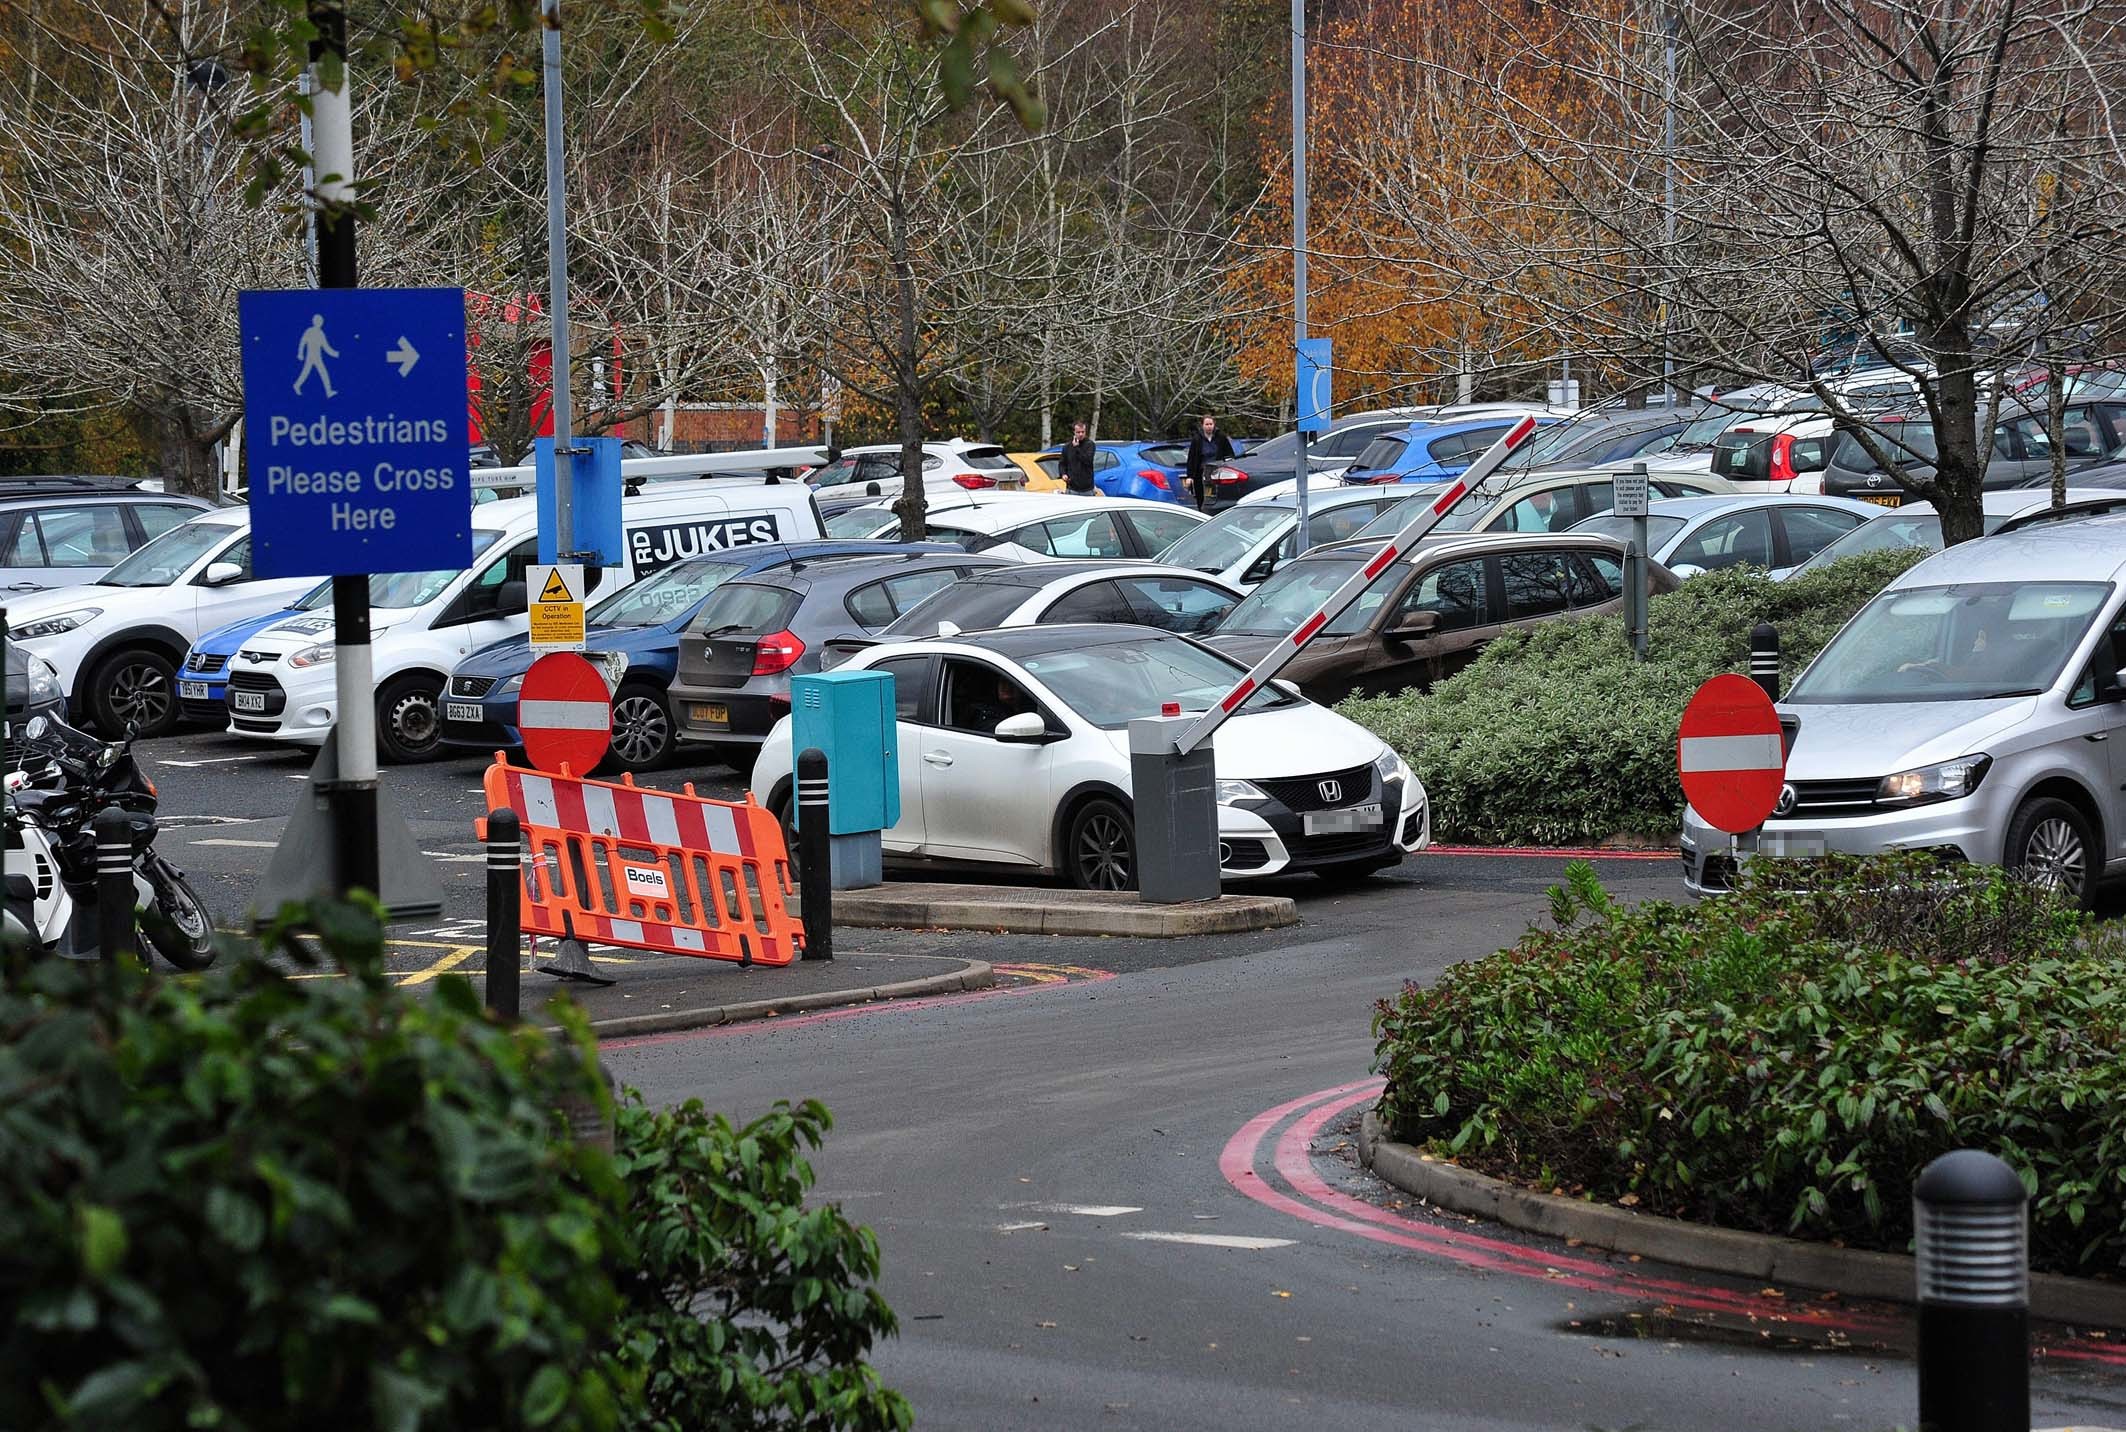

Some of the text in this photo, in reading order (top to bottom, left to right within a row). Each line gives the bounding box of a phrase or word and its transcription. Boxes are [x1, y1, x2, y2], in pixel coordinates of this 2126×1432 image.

[271, 414, 447, 445] Pedestrians
[269, 462, 454, 494] Please Cross
[332, 503, 395, 530] Here
[654, 519, 774, 562] JUKES
[449, 705, 480, 719] BG63 ZXA
[627, 868, 664, 885] Boels
